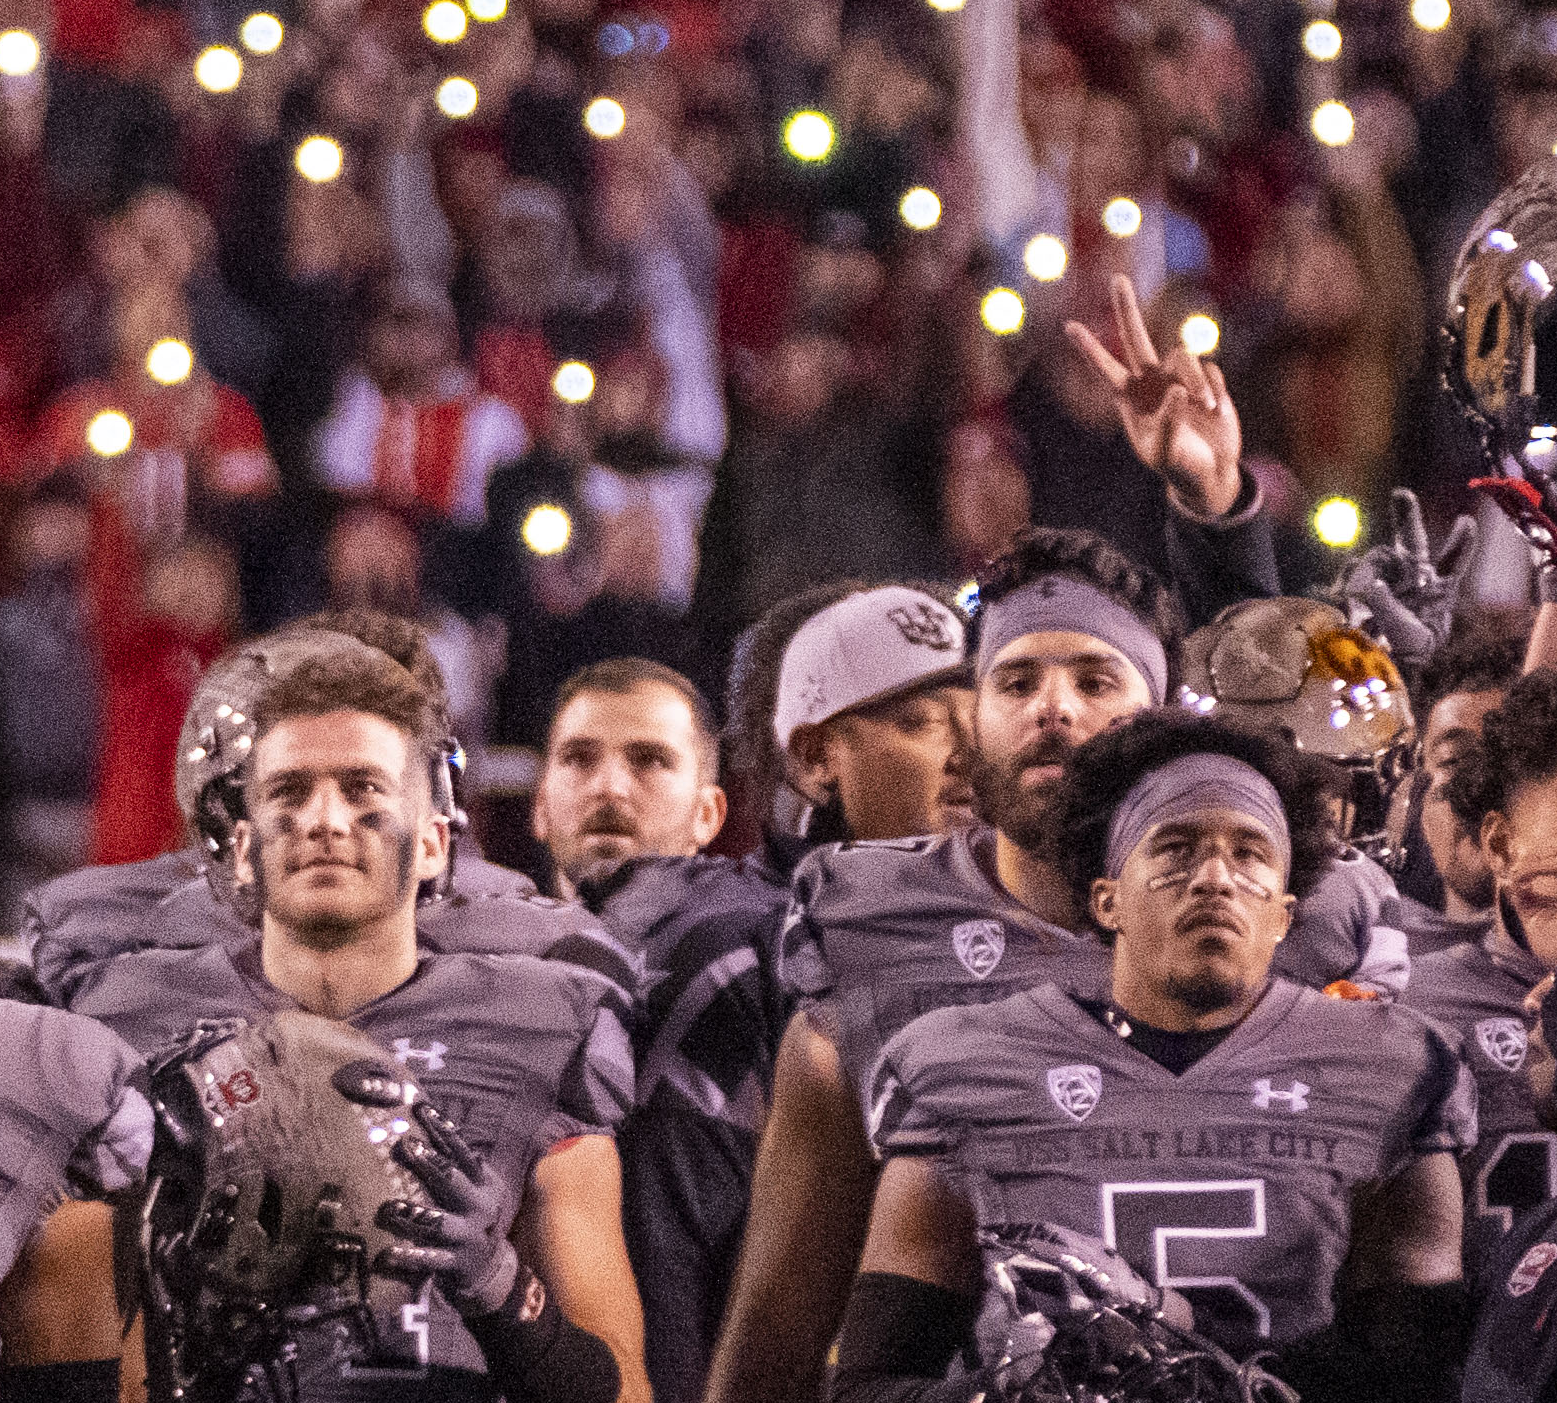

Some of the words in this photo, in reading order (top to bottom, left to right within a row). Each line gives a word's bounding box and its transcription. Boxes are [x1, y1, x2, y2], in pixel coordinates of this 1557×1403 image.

[1085, 1128, 1161, 1162] SALT
[1173, 1129, 1259, 1161] LAKE
[1267, 1129, 1341, 1165] CITY
[1098, 1177, 1269, 1338] 5
